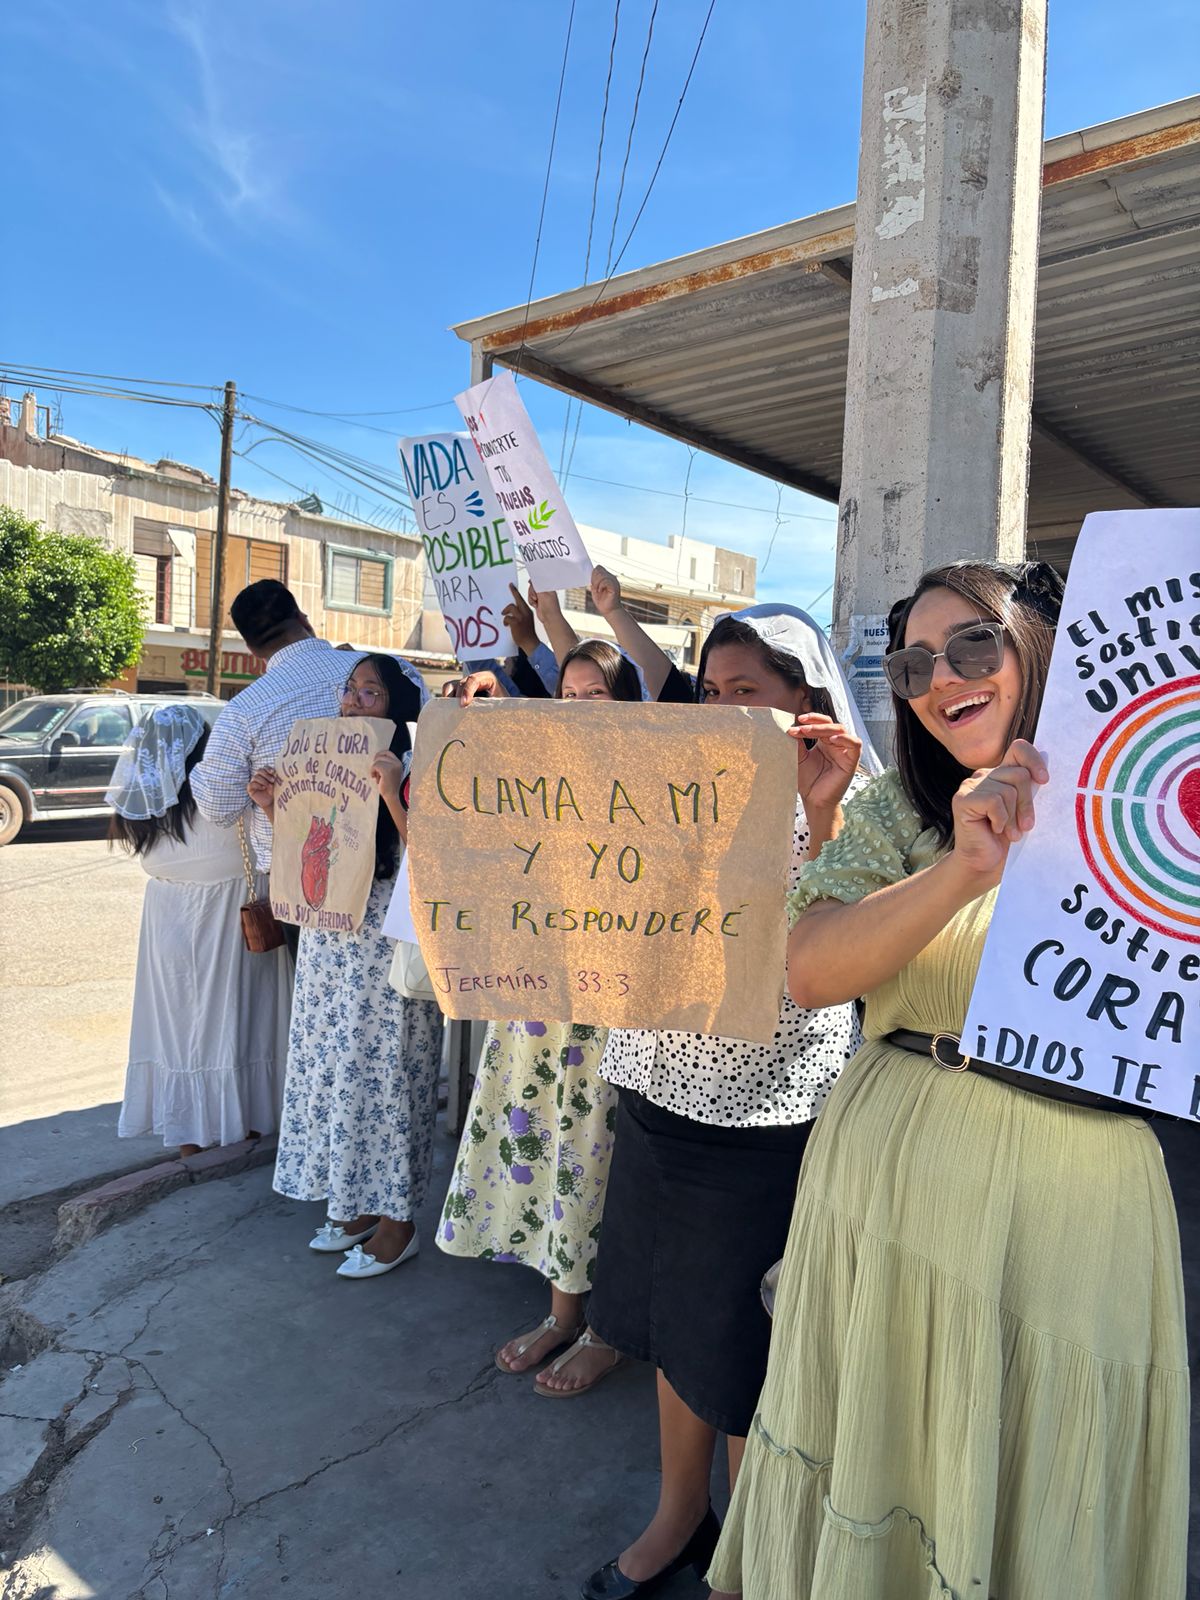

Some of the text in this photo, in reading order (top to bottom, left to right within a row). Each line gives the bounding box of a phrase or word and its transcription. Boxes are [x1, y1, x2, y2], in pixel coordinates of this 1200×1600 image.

[400, 438, 474, 500] NADA
[421, 491, 456, 531] ES
[513, 519, 531, 536] EN
[337, 733, 369, 755] CURA
[282, 761, 298, 778] los
[305, 757, 319, 774] de
[436, 738, 727, 825] CLAMA A MÍ
[277, 775, 336, 811] quebrantado
[514, 841, 642, 884] Y YO
[272, 901, 353, 931] ANA SUS HERIDAS
[424, 900, 474, 932] TE
[436, 966, 631, 996] JEREMÍAS 33:3
[1023, 939, 1185, 1043] CORA
[1111, 1055, 1162, 1104] TE
